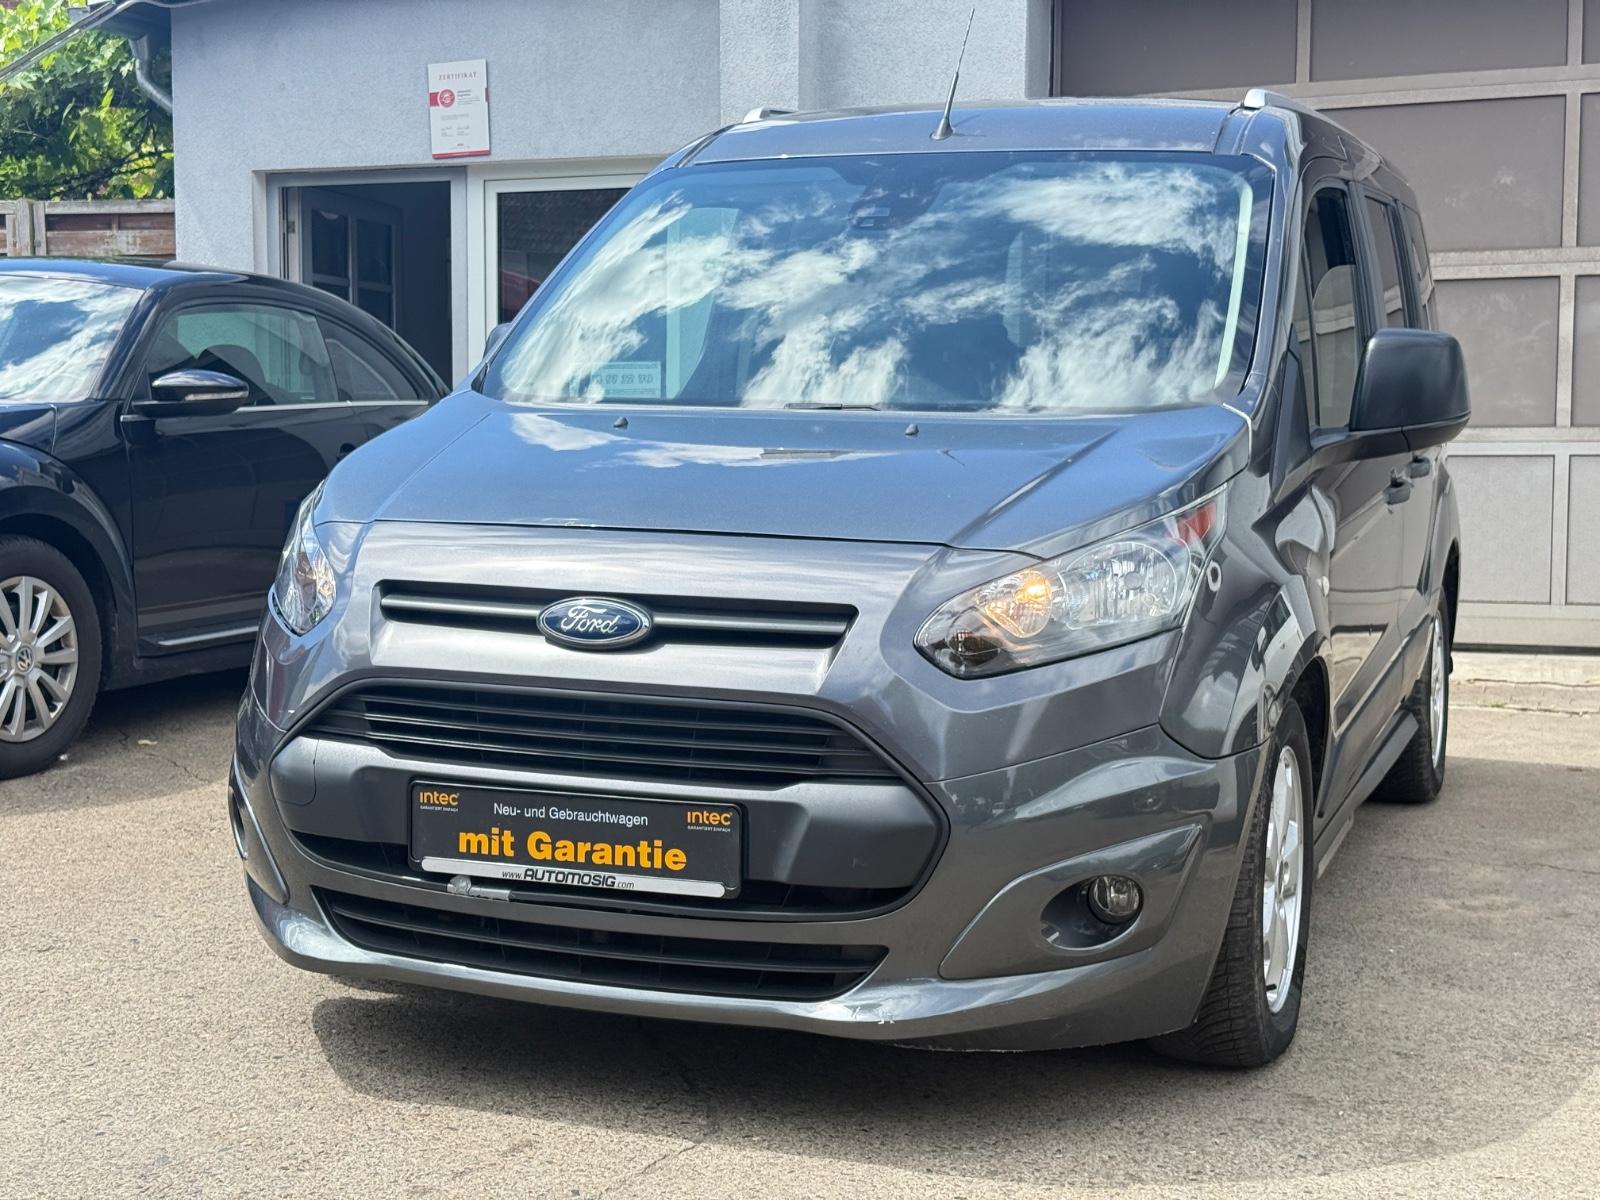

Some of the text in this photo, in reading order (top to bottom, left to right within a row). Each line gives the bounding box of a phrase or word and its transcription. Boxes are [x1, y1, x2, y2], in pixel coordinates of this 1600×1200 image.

[438, 71, 477, 81] ZERTIFIKAT
[560, 605, 621, 634] Ford
[419, 791, 459, 806] intec
[493, 802, 649, 828] Neu- und Gebrauchtwagen
[687, 810, 731, 826] intec
[458, 827, 687, 871] mit Garantie
[502, 868, 635, 889] www.AUTOMOSIG.com
